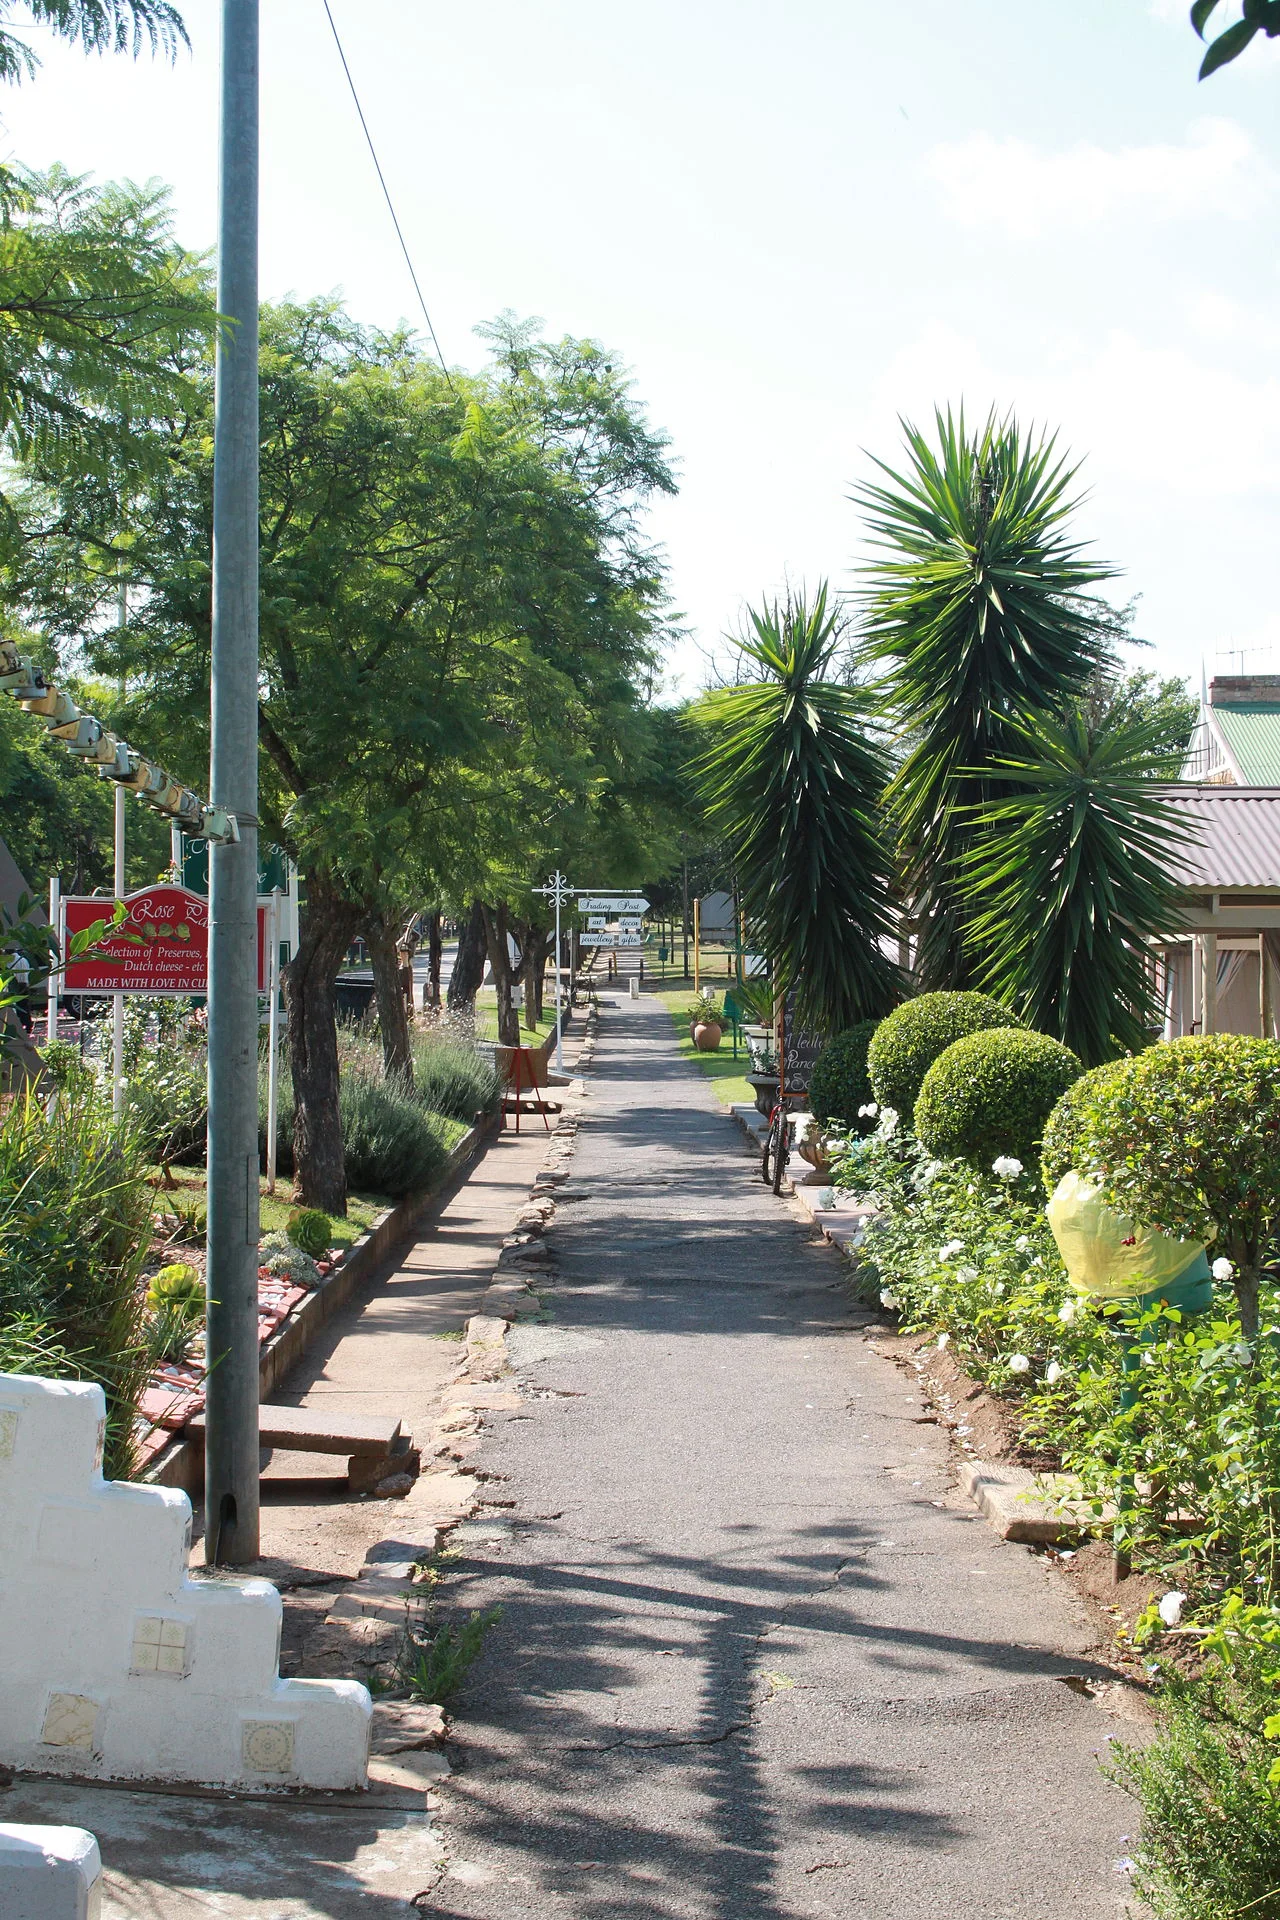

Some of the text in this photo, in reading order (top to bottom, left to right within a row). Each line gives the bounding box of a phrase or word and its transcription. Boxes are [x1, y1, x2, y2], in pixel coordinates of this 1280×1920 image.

[580, 898, 640, 911] Trading Post
[132, 899, 208, 929] Rose Pa
[581, 934, 613, 944] jewellery
[621, 935, 637, 945] gifts
[143, 946, 154, 960] of
[157, 946, 203, 959] Preserves,
[124, 960, 153, 971] Dutch
[155, 960, 184, 972] cheese
[191, 962, 205, 971] etc
[87, 978, 118, 988] MADE
[121, 978, 148, 988] WITH
[150, 978, 176, 988] LOVE
[177, 978, 190, 988] IN
